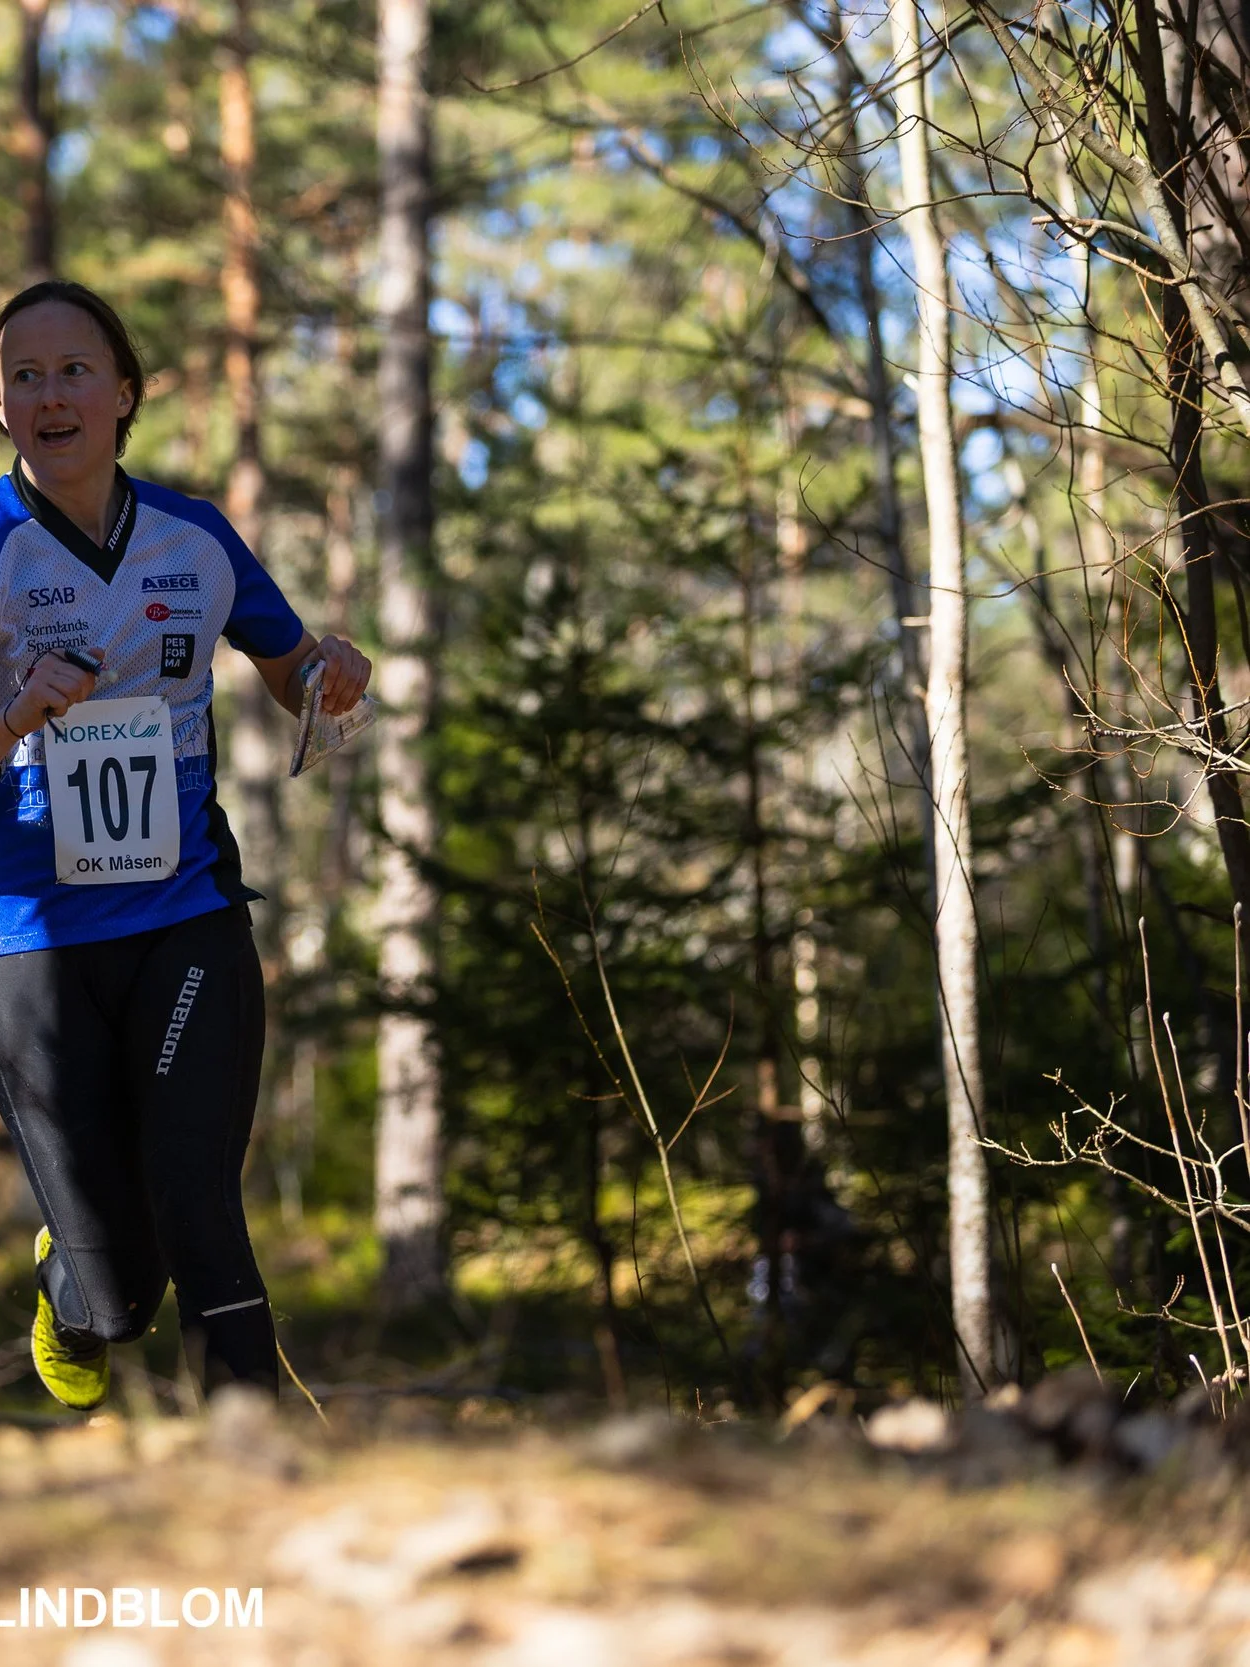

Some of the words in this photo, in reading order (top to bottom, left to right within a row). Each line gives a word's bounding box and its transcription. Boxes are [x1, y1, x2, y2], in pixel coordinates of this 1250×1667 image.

[141, 577, 199, 589] ABECE
[28, 587, 75, 608] SSAB
[25, 619, 89, 638] Sörmlands
[27, 635, 88, 653] Sparbank
[165, 637, 186, 648] PER
[165, 648, 186, 660] FOR
[54, 723, 127, 744] NOREX
[67, 755, 157, 843] 107
[76, 857, 104, 872] OK
[109, 854, 162, 871] Måsen
[156, 966, 204, 1075] noname
